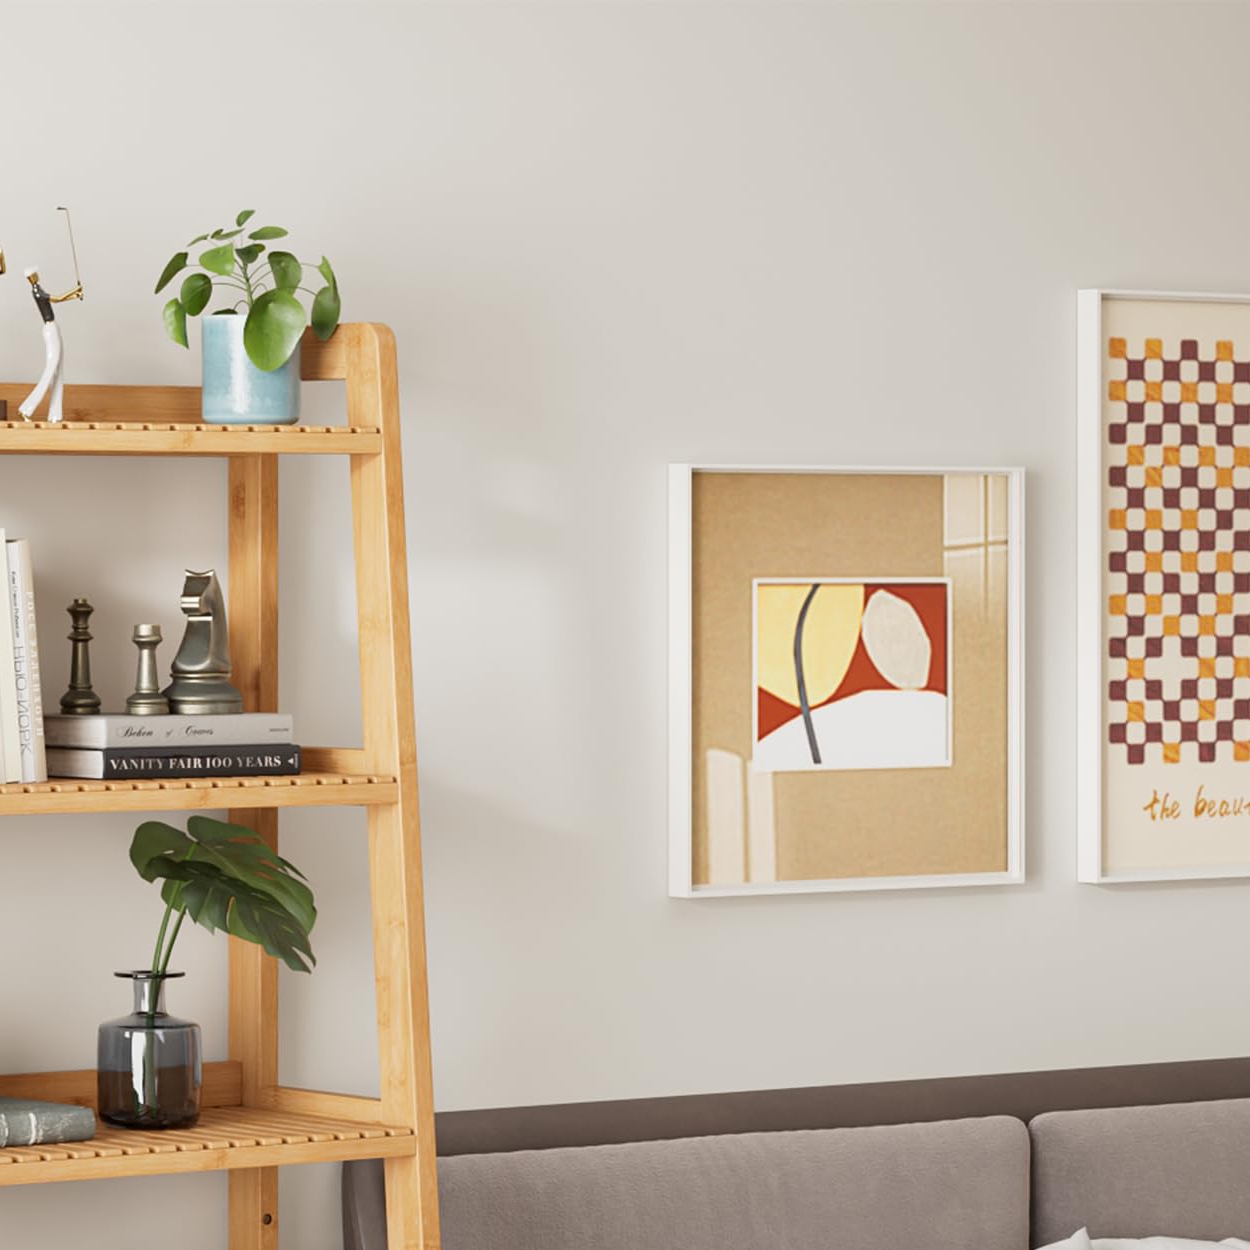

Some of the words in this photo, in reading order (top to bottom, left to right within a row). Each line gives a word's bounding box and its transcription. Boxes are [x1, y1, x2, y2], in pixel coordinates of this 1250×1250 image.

[14, 645, 32, 754] НЬЮ-ЙОРК
[110, 757, 165, 771] VANITY
[169, 757, 202, 770] FAIR
[206, 756, 232, 768] 100
[237, 755, 282, 768] YEARS
[1143, 789, 1181, 821] the
[1194, 784, 1250, 818] beau
